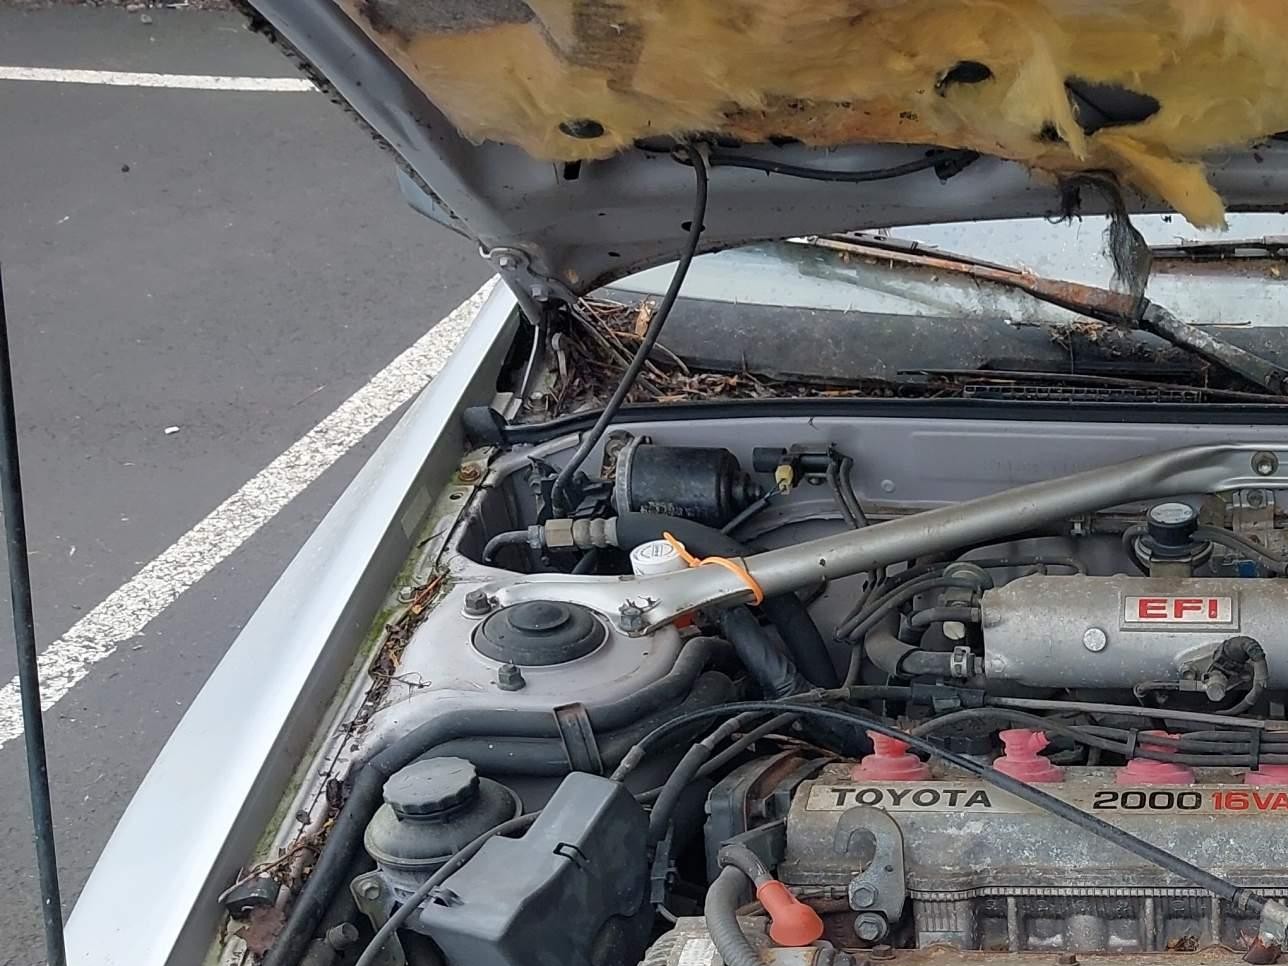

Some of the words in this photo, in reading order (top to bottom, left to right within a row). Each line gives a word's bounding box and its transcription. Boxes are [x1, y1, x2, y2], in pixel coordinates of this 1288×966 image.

[1139, 599, 1217, 618] EFI
[831, 788, 991, 807] TOYOTA
[1093, 791, 1202, 809] 2000
